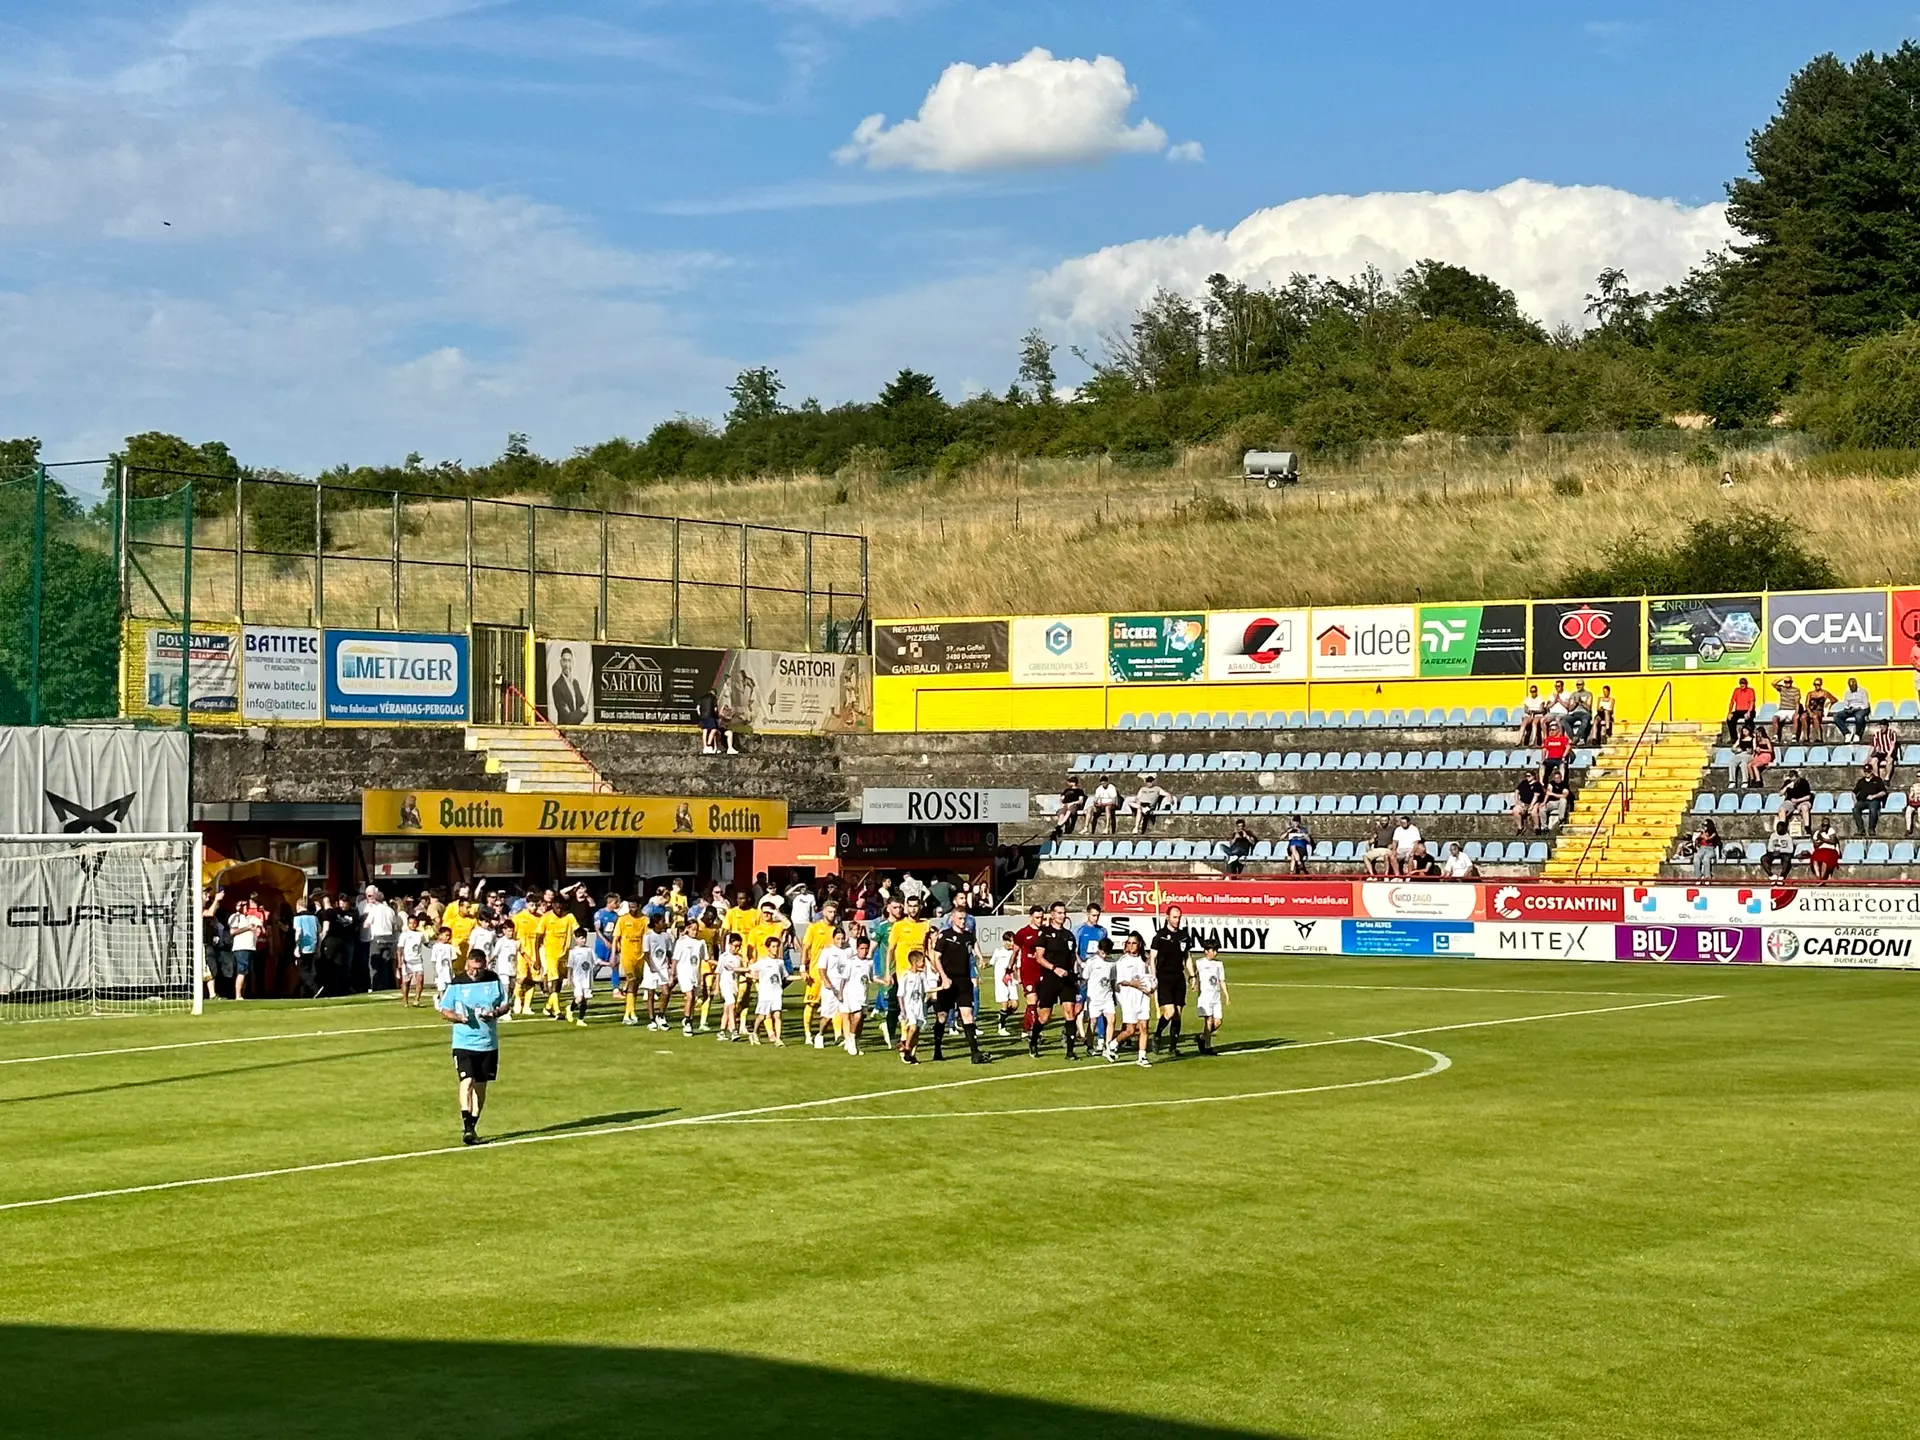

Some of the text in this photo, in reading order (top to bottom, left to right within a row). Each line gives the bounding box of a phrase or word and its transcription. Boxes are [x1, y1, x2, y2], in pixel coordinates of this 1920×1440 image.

[892, 624, 940, 634] RESTAURANT
[905, 633, 940, 641] PIZZERIA
[1113, 627, 1157, 640] DECKER
[1773, 611, 1883, 645] OCEAL
[158, 634, 210, 649] POLSAN
[245, 634, 318, 654] BATITEC
[1354, 623, 1410, 656] idee
[1563, 651, 1608, 660] OPTICAL
[356, 656, 453, 681] METZGER
[779, 659, 835, 677] SARTORI
[891, 664, 940, 674] GARIBALDI
[1563, 662, 1607, 671] CENTER
[601, 672, 662, 692] SARTORI
[246, 698, 317, 712] info@batitec.lu
[330, 701, 465, 715] Votre fabricant VÉRANDAS-PERGOLAS
[439, 797, 761, 833] Battin Buvette Battin
[907, 791, 979, 821] ROSSI
[1524, 896, 1617, 911] COSTANTINI
[1799, 893, 1920, 913] amarcord
[1499, 926, 1588, 957] MITEX
[1632, 929, 1668, 952] BIL
[1697, 930, 1734, 953] BIL
[1834, 928, 1880, 937] GARAGE
[1803, 938, 1913, 957] CARDONI
